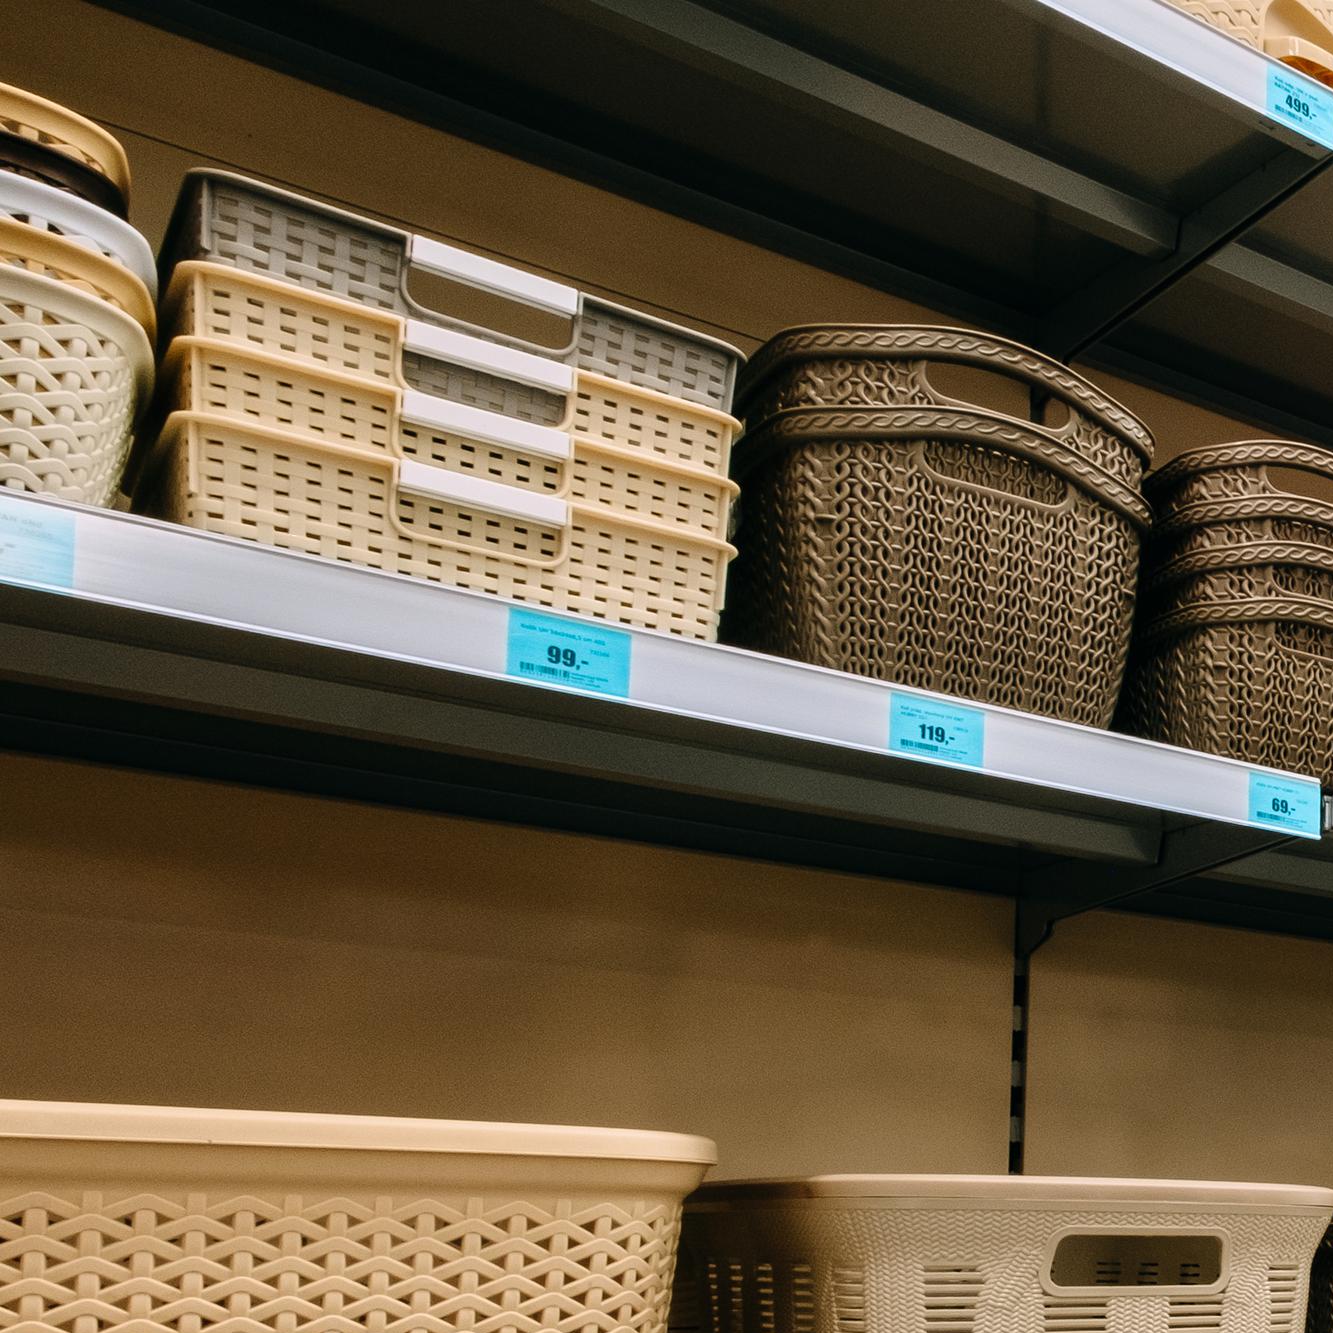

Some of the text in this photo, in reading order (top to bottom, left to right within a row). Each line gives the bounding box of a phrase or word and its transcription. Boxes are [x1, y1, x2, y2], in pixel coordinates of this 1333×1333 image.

[1285, 95, 1317, 120] 499,-
[547, 645, 589, 670] 99,-
[918, 723, 955, 745] 119,-
[1272, 798, 1296, 816] 69,-
